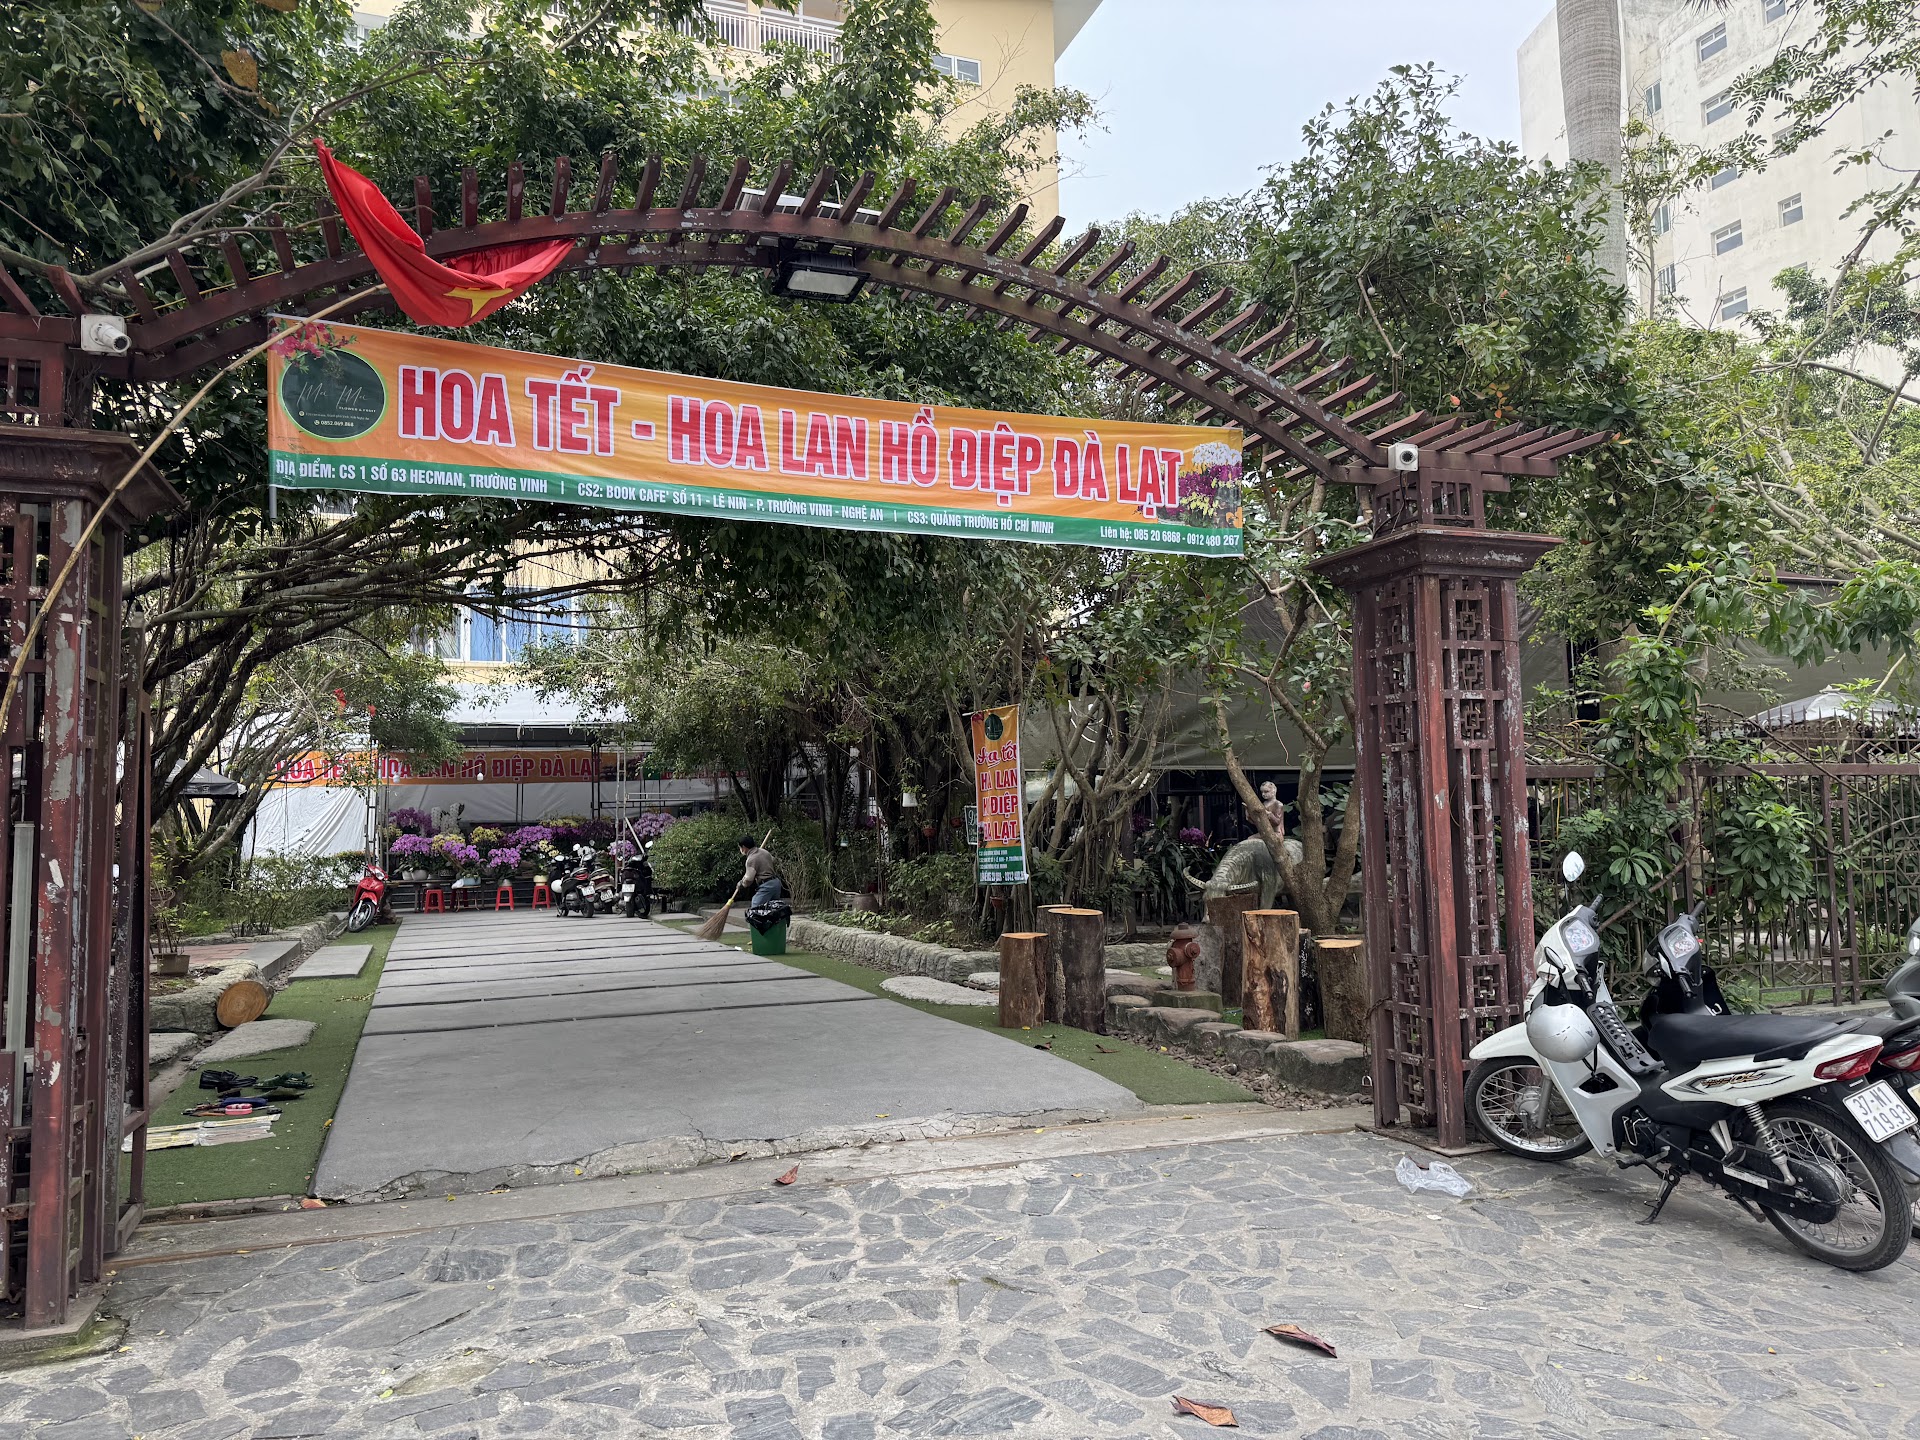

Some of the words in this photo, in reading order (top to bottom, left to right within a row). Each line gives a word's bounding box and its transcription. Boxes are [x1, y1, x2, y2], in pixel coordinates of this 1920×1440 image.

[399, 366, 516, 447] HOA
[526, 365, 621, 456] TẾT
[668, 395, 769, 471] HOA
[779, 408, 868, 480] LAN
[879, 406, 939, 488] HỒ
[948, 421, 1043, 507] ĐIỆP
[1052, 430, 1109, 501] ĐÀ
[1116, 444, 1184, 519] LẠT
[276, 459, 296, 477] ĐỊA
[299, 458, 335, 478] ĐIỂM:
[339, 464, 355, 480] CS
[360, 466, 366, 480] 1
[371, 462, 388, 481] SỐ
[391, 468, 406, 482] 63
[410, 469, 466, 488] HECMAN,
[469, 472, 517, 491] TRƯỜNG
[520, 477, 548, 493] VINH
[577, 482, 603, 498] CS2:
[606, 485, 636, 500] BOOK
[673, 488, 687, 505] SỐ
[690, 493, 702, 507] 11
[713, 492, 725, 508] LÊ
[728, 496, 747, 510] NIN
[756, 499, 765, 512] P.
[767, 498, 807, 515] TRƯỜNG
[809, 503, 833, 517] VINH
[842, 505, 867, 523] NGHỆ
[870, 509, 883, 521] AN
[907, 511, 928, 525] CS3:
[930, 510, 961, 527] QUẢNG
[963, 515, 998, 530] TRƯỜNG
[1015, 518, 1029, 532] CHÍ
[1031, 520, 1054, 534] MINH
[1100, 526, 1117, 539] Liên
[1120, 526, 1132, 541] hệ:
[1134, 529, 1149, 541] 085
[1150, 530, 1160, 541] 20
[1162, 531, 1180, 543] 6868
[1187, 533, 1204, 546] 0912
[1205, 535, 1220, 547] 480
[1223, 534, 1240, 546] 267
[492, 753, 535, 781] ĐIỆP
[540, 753, 566, 778] ĐÀ
[993, 820, 1017, 844] LẠT
[1853, 1086, 1893, 1115] 37-N1
[1864, 1104, 1912, 1138] 719.93
